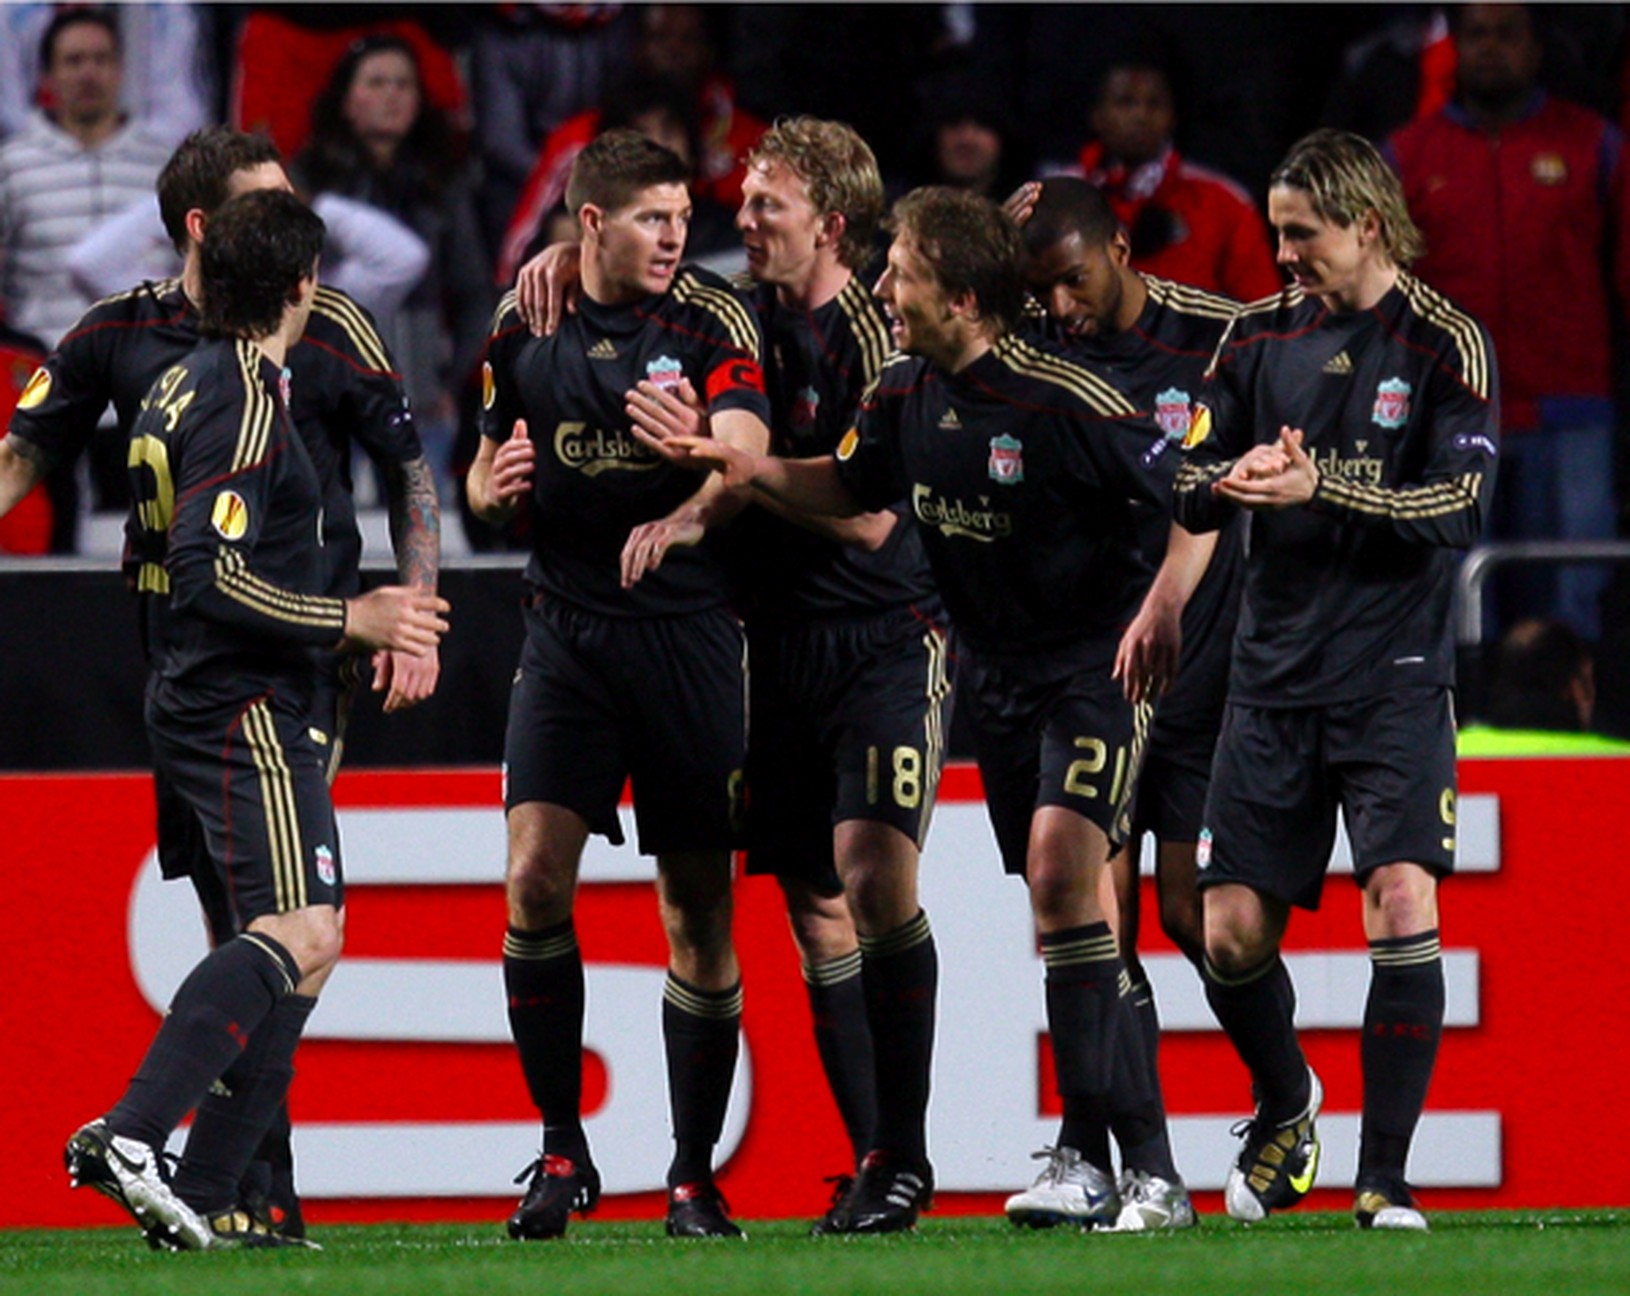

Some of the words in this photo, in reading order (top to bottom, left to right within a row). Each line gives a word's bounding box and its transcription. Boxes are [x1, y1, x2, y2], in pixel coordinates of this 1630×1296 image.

[730, 363, 758, 389] C
[554, 421, 661, 470] Carlsbe
[1308, 446, 1383, 486] lsberg
[912, 481, 1013, 538] Carlsberg
[866, 744, 922, 809] 18
[1063, 736, 1127, 806] 21
